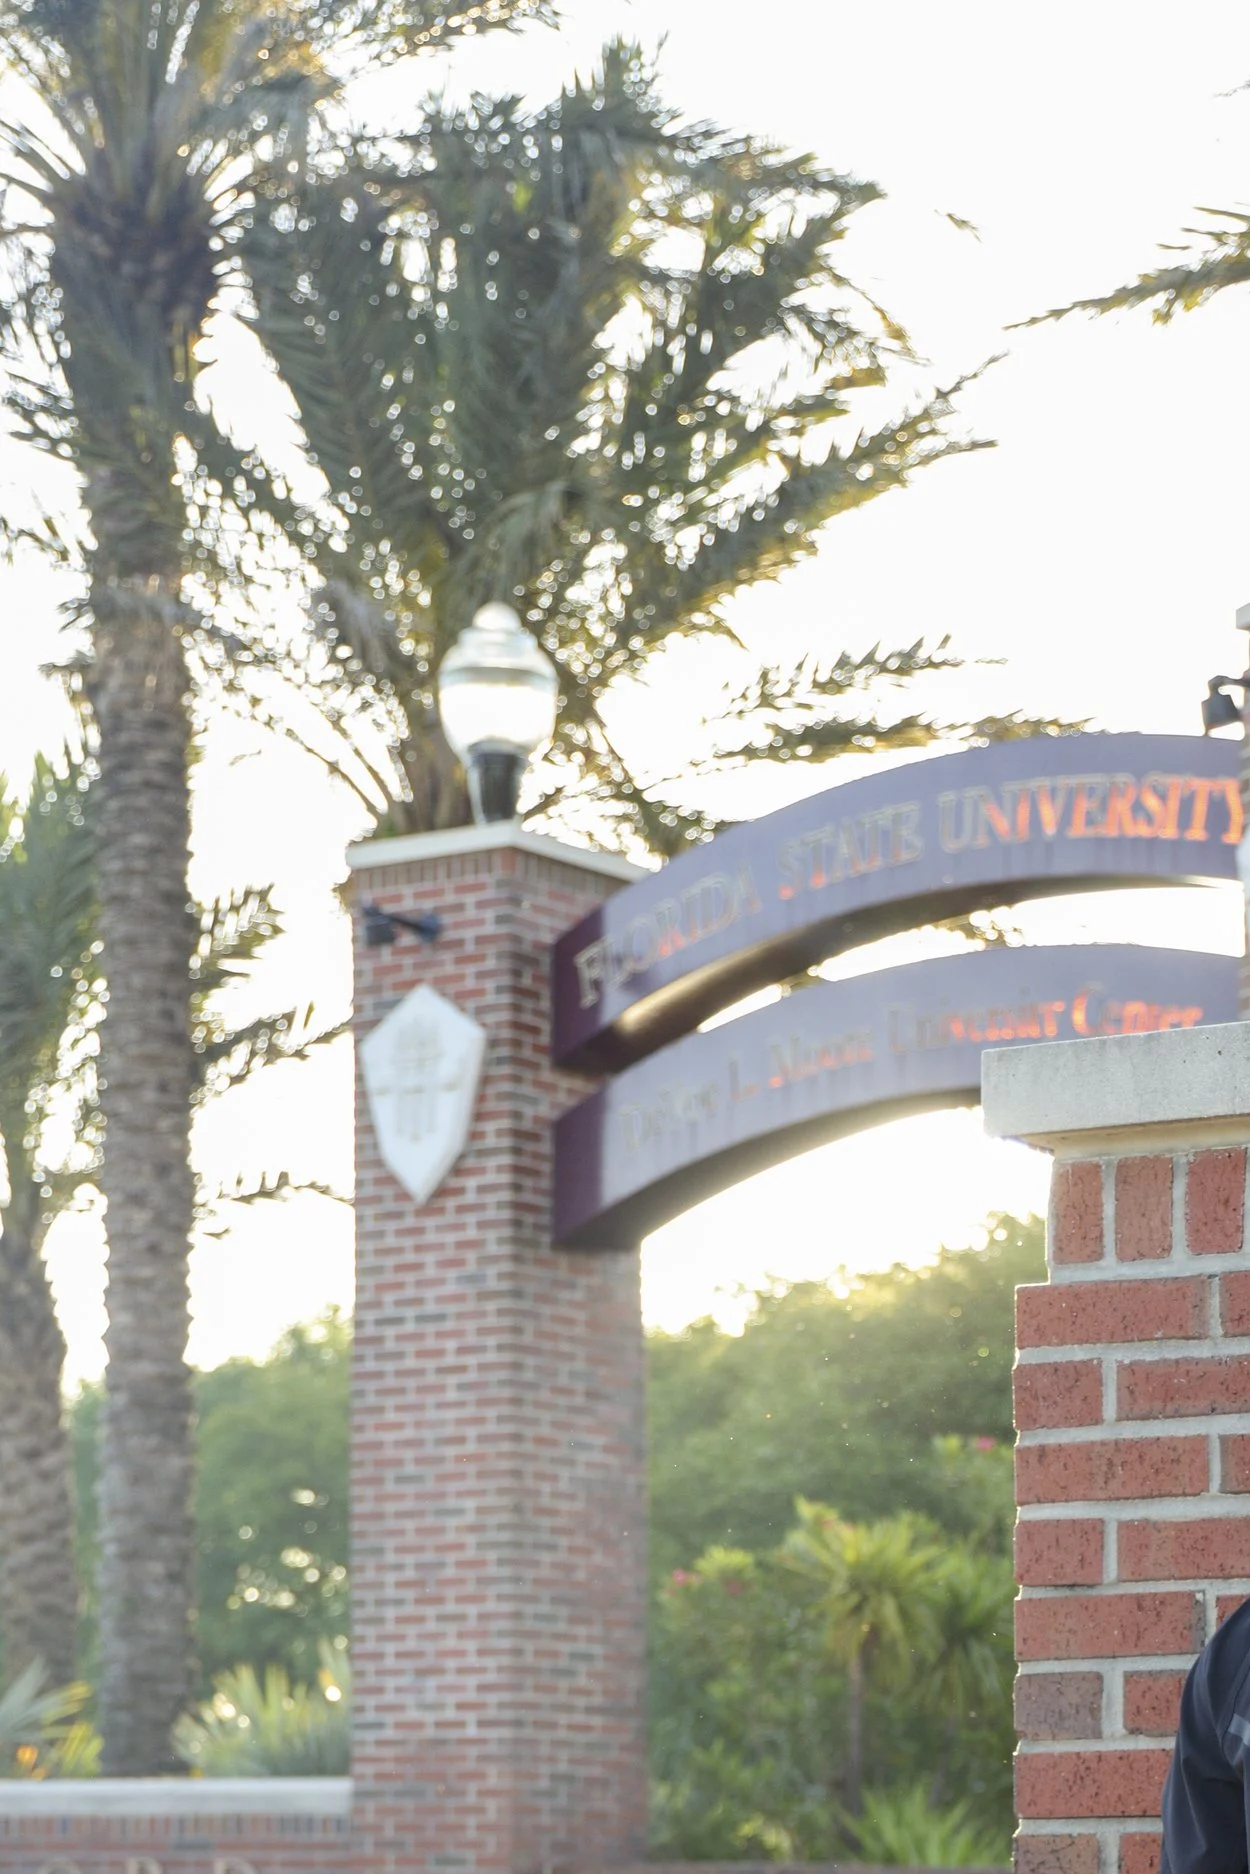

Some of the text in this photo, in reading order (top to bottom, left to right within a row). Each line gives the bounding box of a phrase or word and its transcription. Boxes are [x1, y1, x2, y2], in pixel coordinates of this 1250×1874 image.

[573, 771, 1245, 1009] FLORIDA STATE UNIVERSITY
